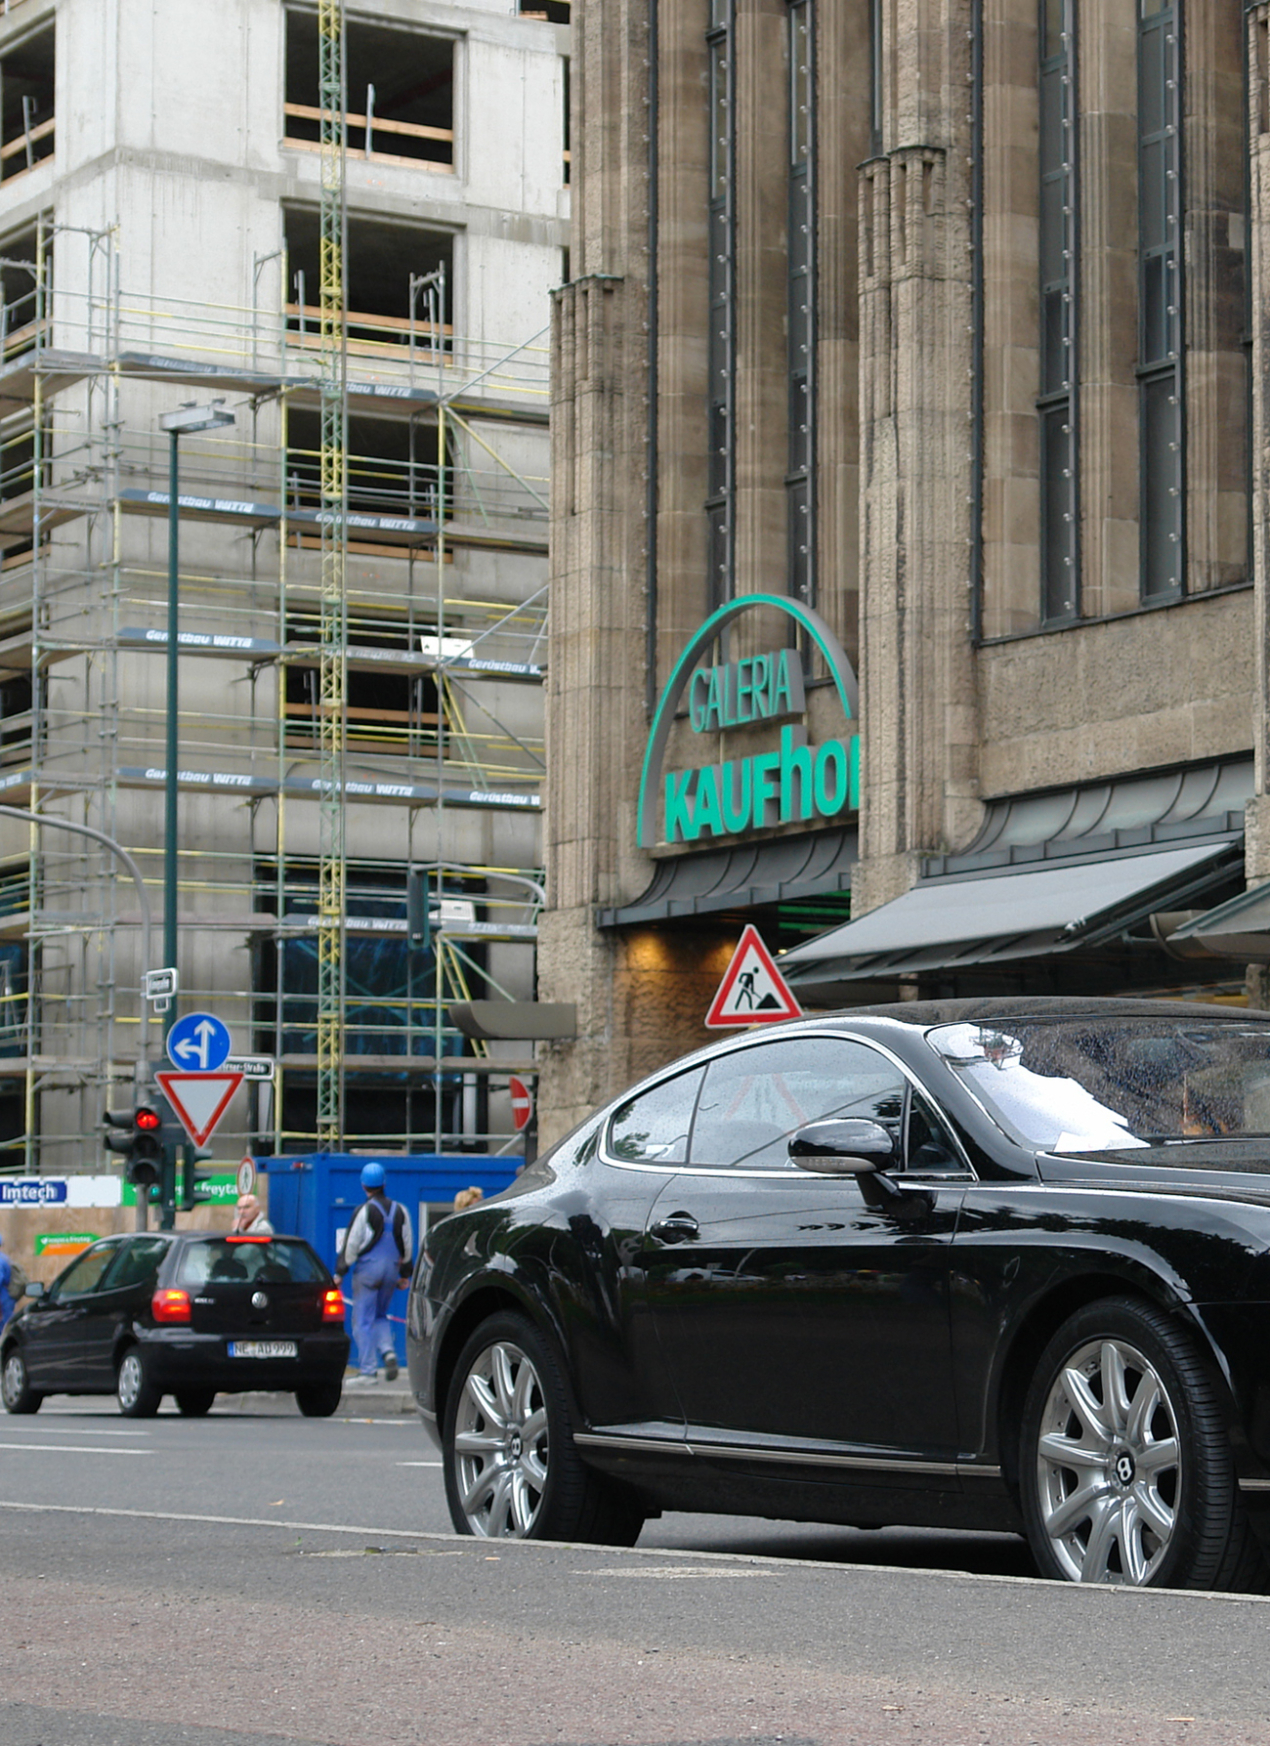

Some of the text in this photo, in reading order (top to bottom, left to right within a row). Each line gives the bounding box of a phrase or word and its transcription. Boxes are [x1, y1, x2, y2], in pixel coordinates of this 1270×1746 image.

[147, 492, 211, 508] Gerstbau
[146, 629, 210, 645] Gertbau
[689, 648, 793, 733] GALERIA
[145, 768, 210, 782] Gertbau
[2, 1184, 56, 1200] Imtech
[201, 1182, 239, 1196] freyta
